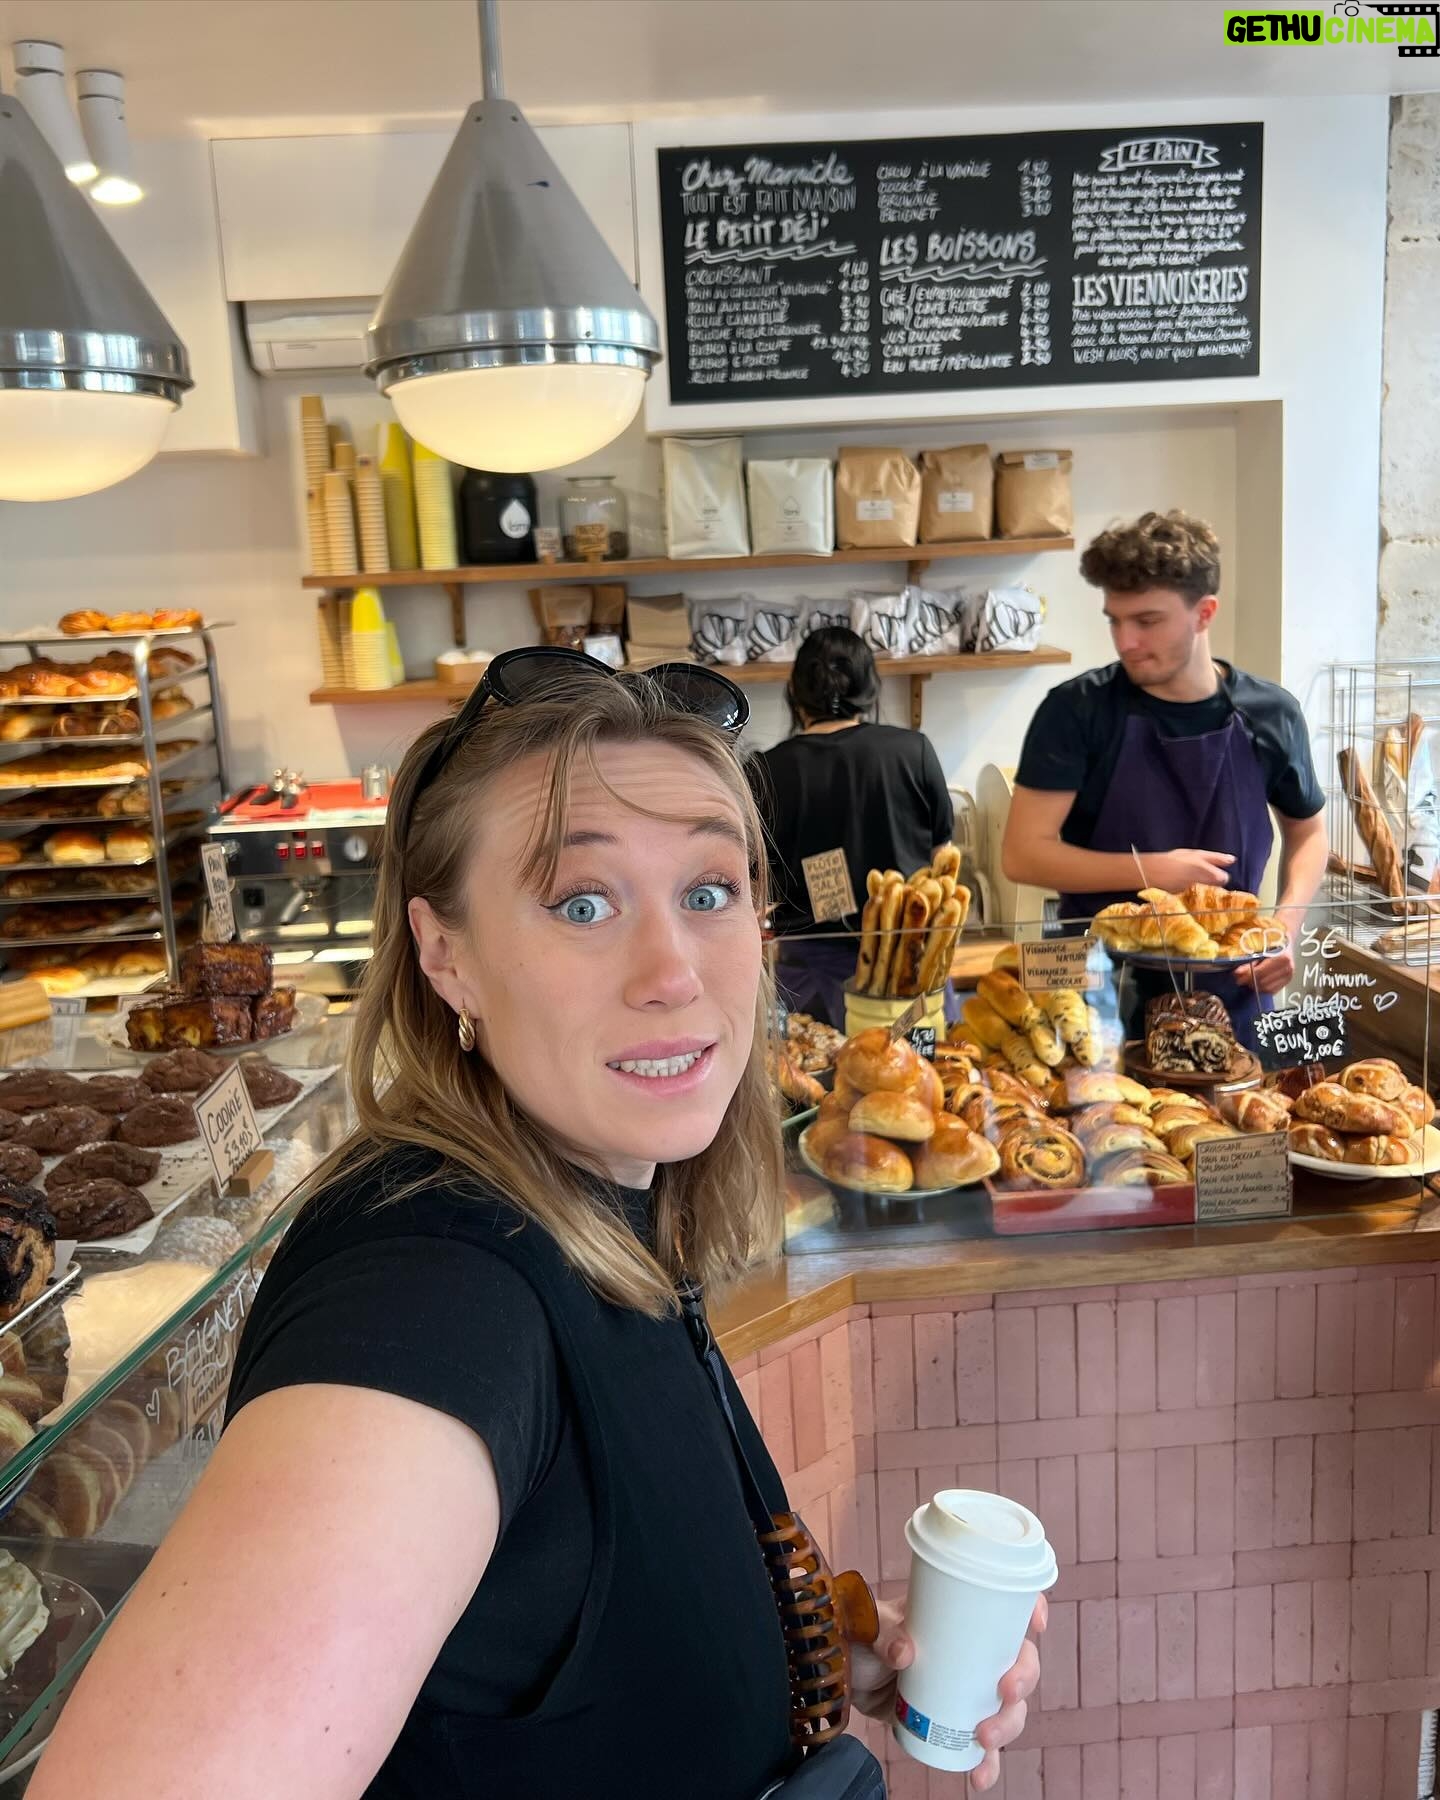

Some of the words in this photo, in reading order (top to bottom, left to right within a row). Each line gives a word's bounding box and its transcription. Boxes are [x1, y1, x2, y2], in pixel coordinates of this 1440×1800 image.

[1128, 144, 1150, 162] LE
[1153, 141, 1194, 162] PAIN
[680, 191, 720, 215] TOUT
[723, 192, 749, 215] EST
[755, 189, 792, 214] FAIT
[793, 185, 857, 214] MAISON
[684, 219, 711, 249] LE
[716, 213, 776, 247] PETIT
[880, 233, 918, 266] LES
[926, 226, 1036, 263] BOISSONS
[685, 265, 778, 287] CROISSANT
[1072, 274, 1107, 307] LES
[1108, 266, 1248, 306] VIENNOISERIES
[1303, 962, 1377, 988] Minimum
[1262, 1011, 1293, 1034] HOT
[1274, 1027, 1308, 1054] BUN
[166, 1273, 249, 1392] BEIGNET
